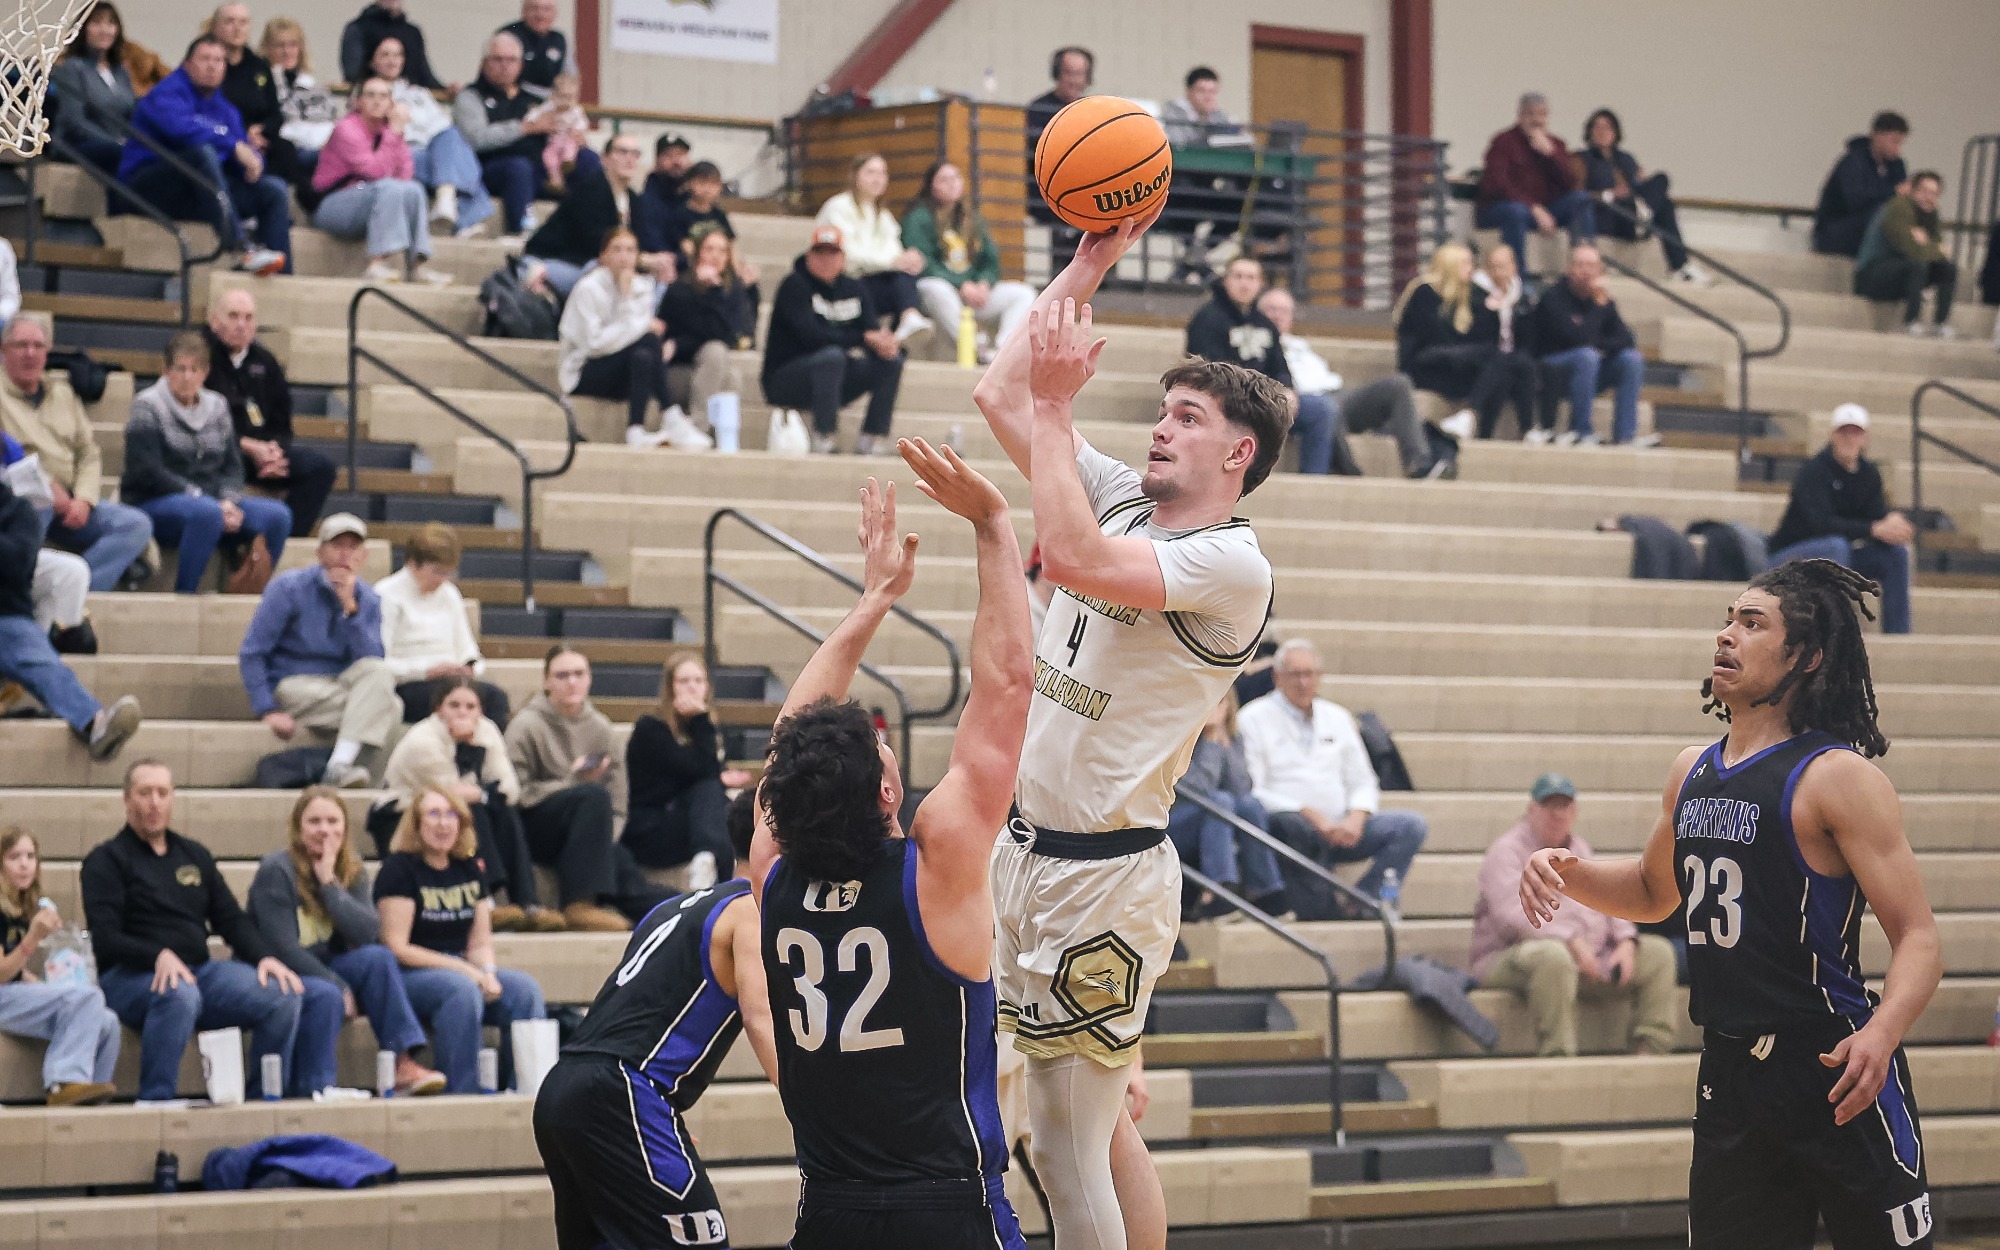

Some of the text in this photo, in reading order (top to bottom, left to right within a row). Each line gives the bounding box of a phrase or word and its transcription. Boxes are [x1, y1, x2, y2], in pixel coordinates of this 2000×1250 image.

[1092, 164, 1170, 213] Wilson
[1067, 609, 1088, 668] 4
[1676, 798, 1760, 844] SPARTANS
[1683, 854, 1743, 949] 23
[616, 913, 682, 987] 0
[777, 927, 905, 1052] 32
